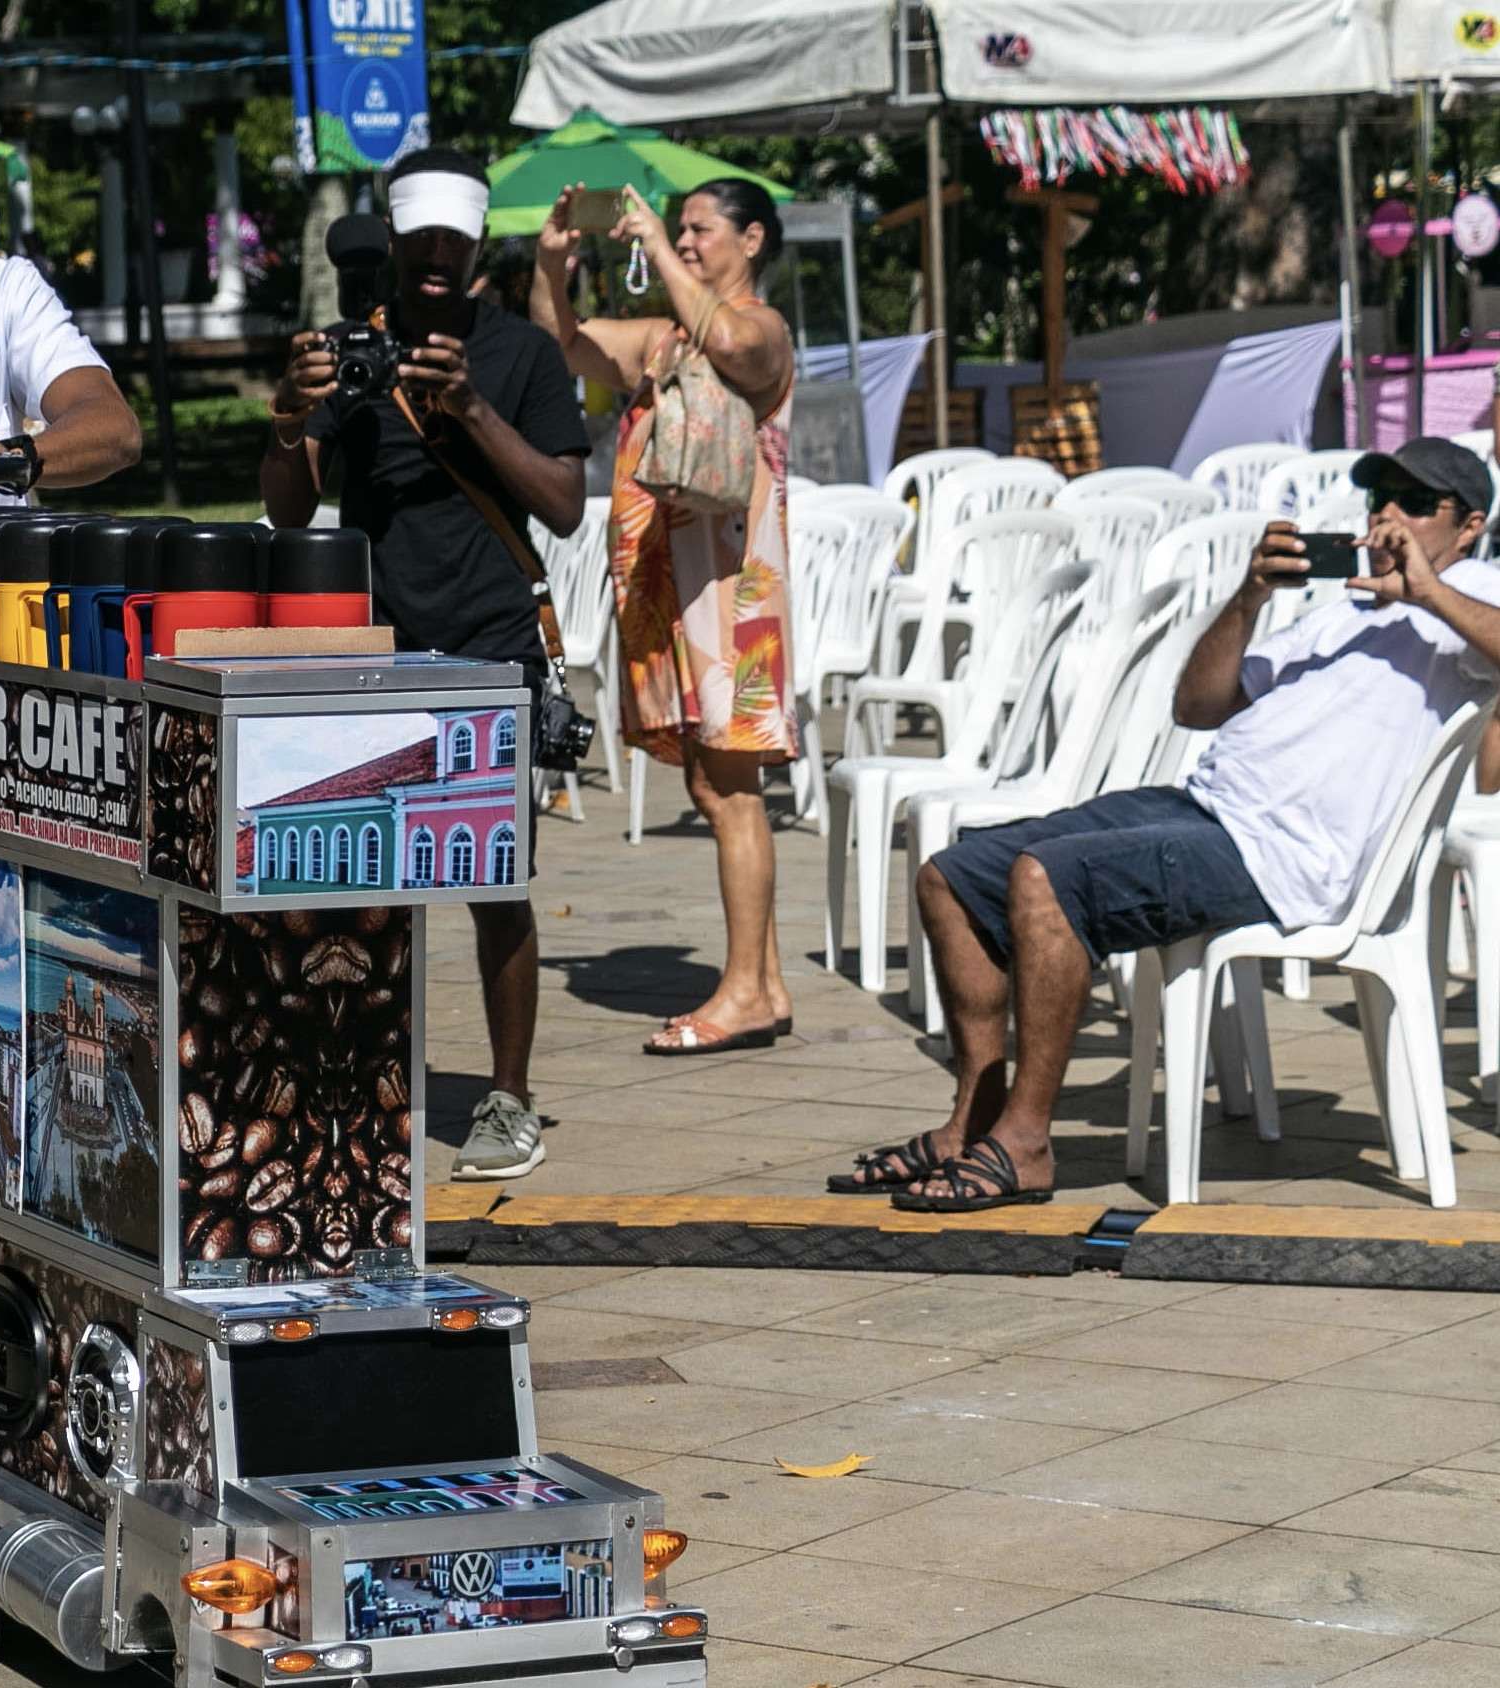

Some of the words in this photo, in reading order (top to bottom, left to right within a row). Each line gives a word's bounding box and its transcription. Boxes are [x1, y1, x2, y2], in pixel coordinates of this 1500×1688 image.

[16, 781, 97, 819] ACHOCOLATADO
[105, 792, 128, 828] CHÁ
[38, 819, 59, 843] AINDA
[69, 826, 88, 850] QUEM
[90, 830, 117, 858] PREFIRA
